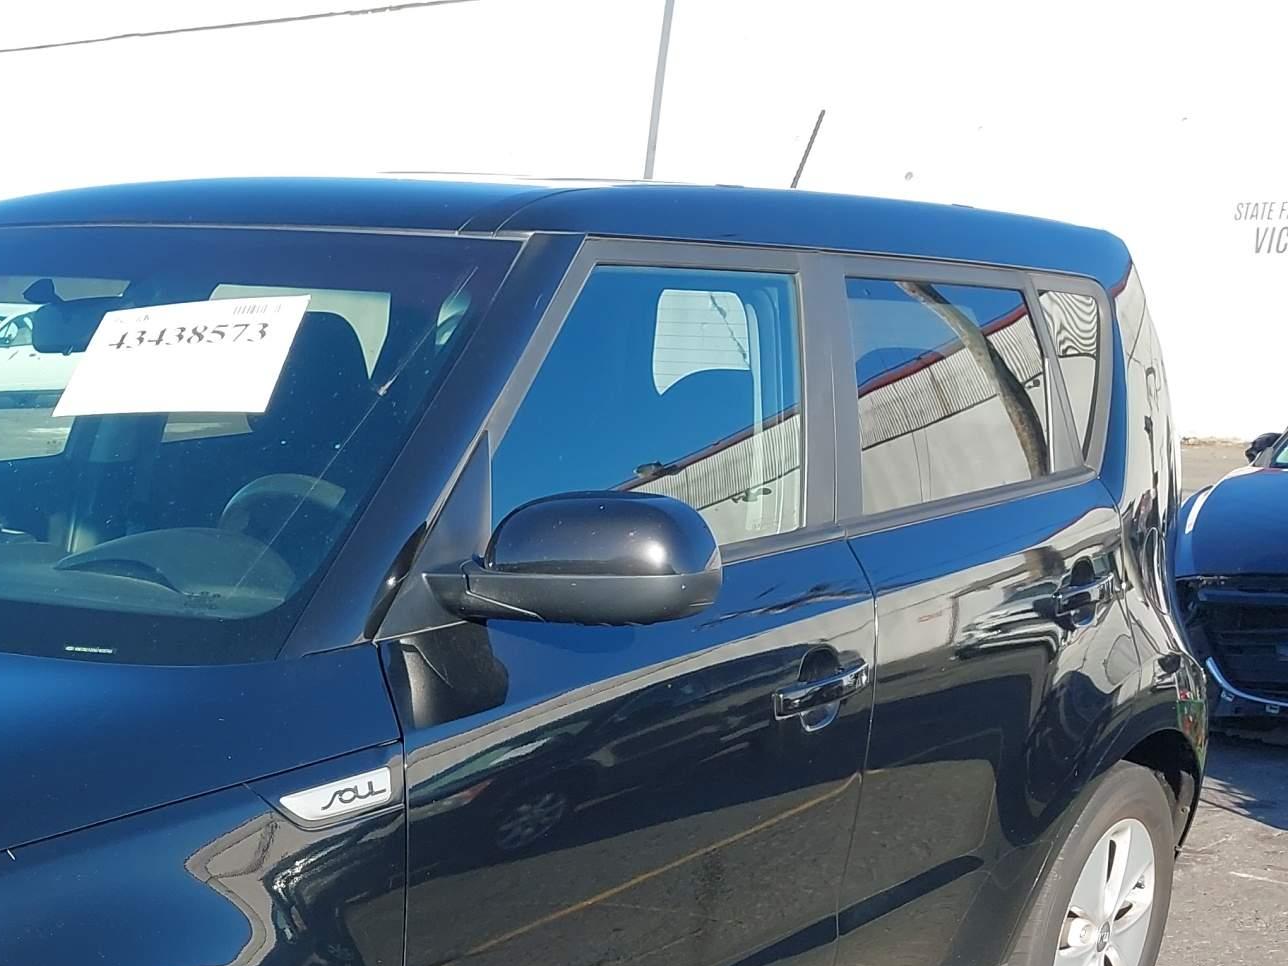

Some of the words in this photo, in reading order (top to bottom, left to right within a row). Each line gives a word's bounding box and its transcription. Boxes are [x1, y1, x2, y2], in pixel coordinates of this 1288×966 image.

[1234, 202, 1275, 221] STATE
[1279, 202, 1288, 220] F
[108, 322, 269, 350] 43438573
